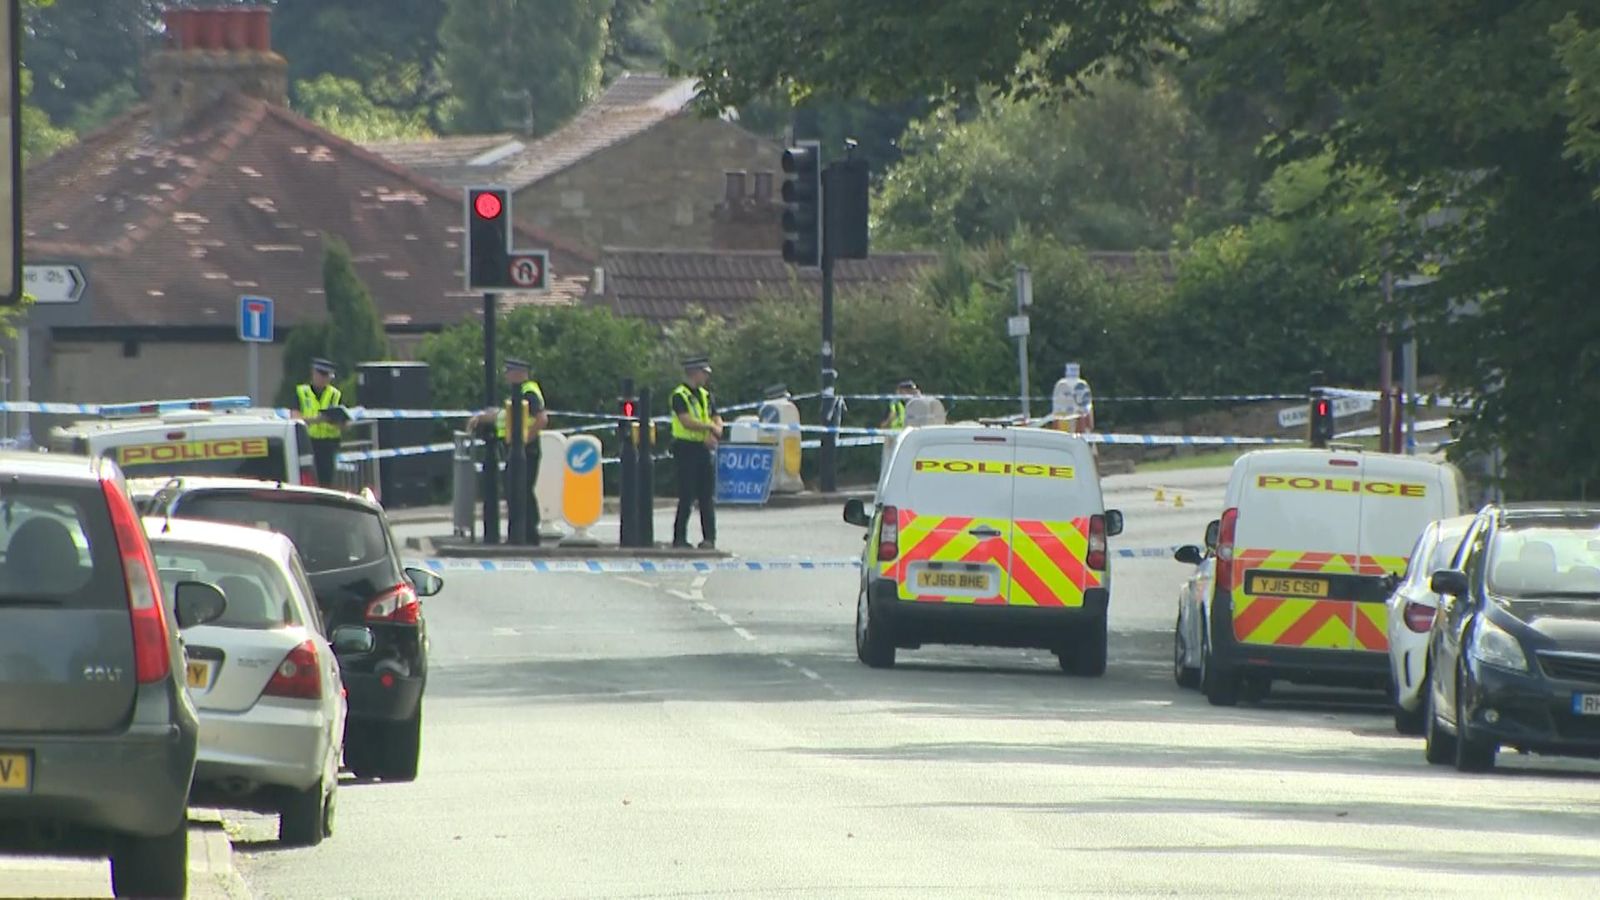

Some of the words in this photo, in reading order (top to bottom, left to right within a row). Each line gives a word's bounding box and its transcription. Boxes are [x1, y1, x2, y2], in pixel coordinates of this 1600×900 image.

[123, 440, 265, 463] POLICE
[719, 453, 771, 470] POLICE
[915, 460, 1073, 478] POLICE
[1258, 475, 1426, 497] POLICE
[923, 575, 956, 586] YJ66
[960, 576, 984, 588] BHE
[1261, 579, 1290, 591] YJ15
[83, 664, 122, 682] COLT
